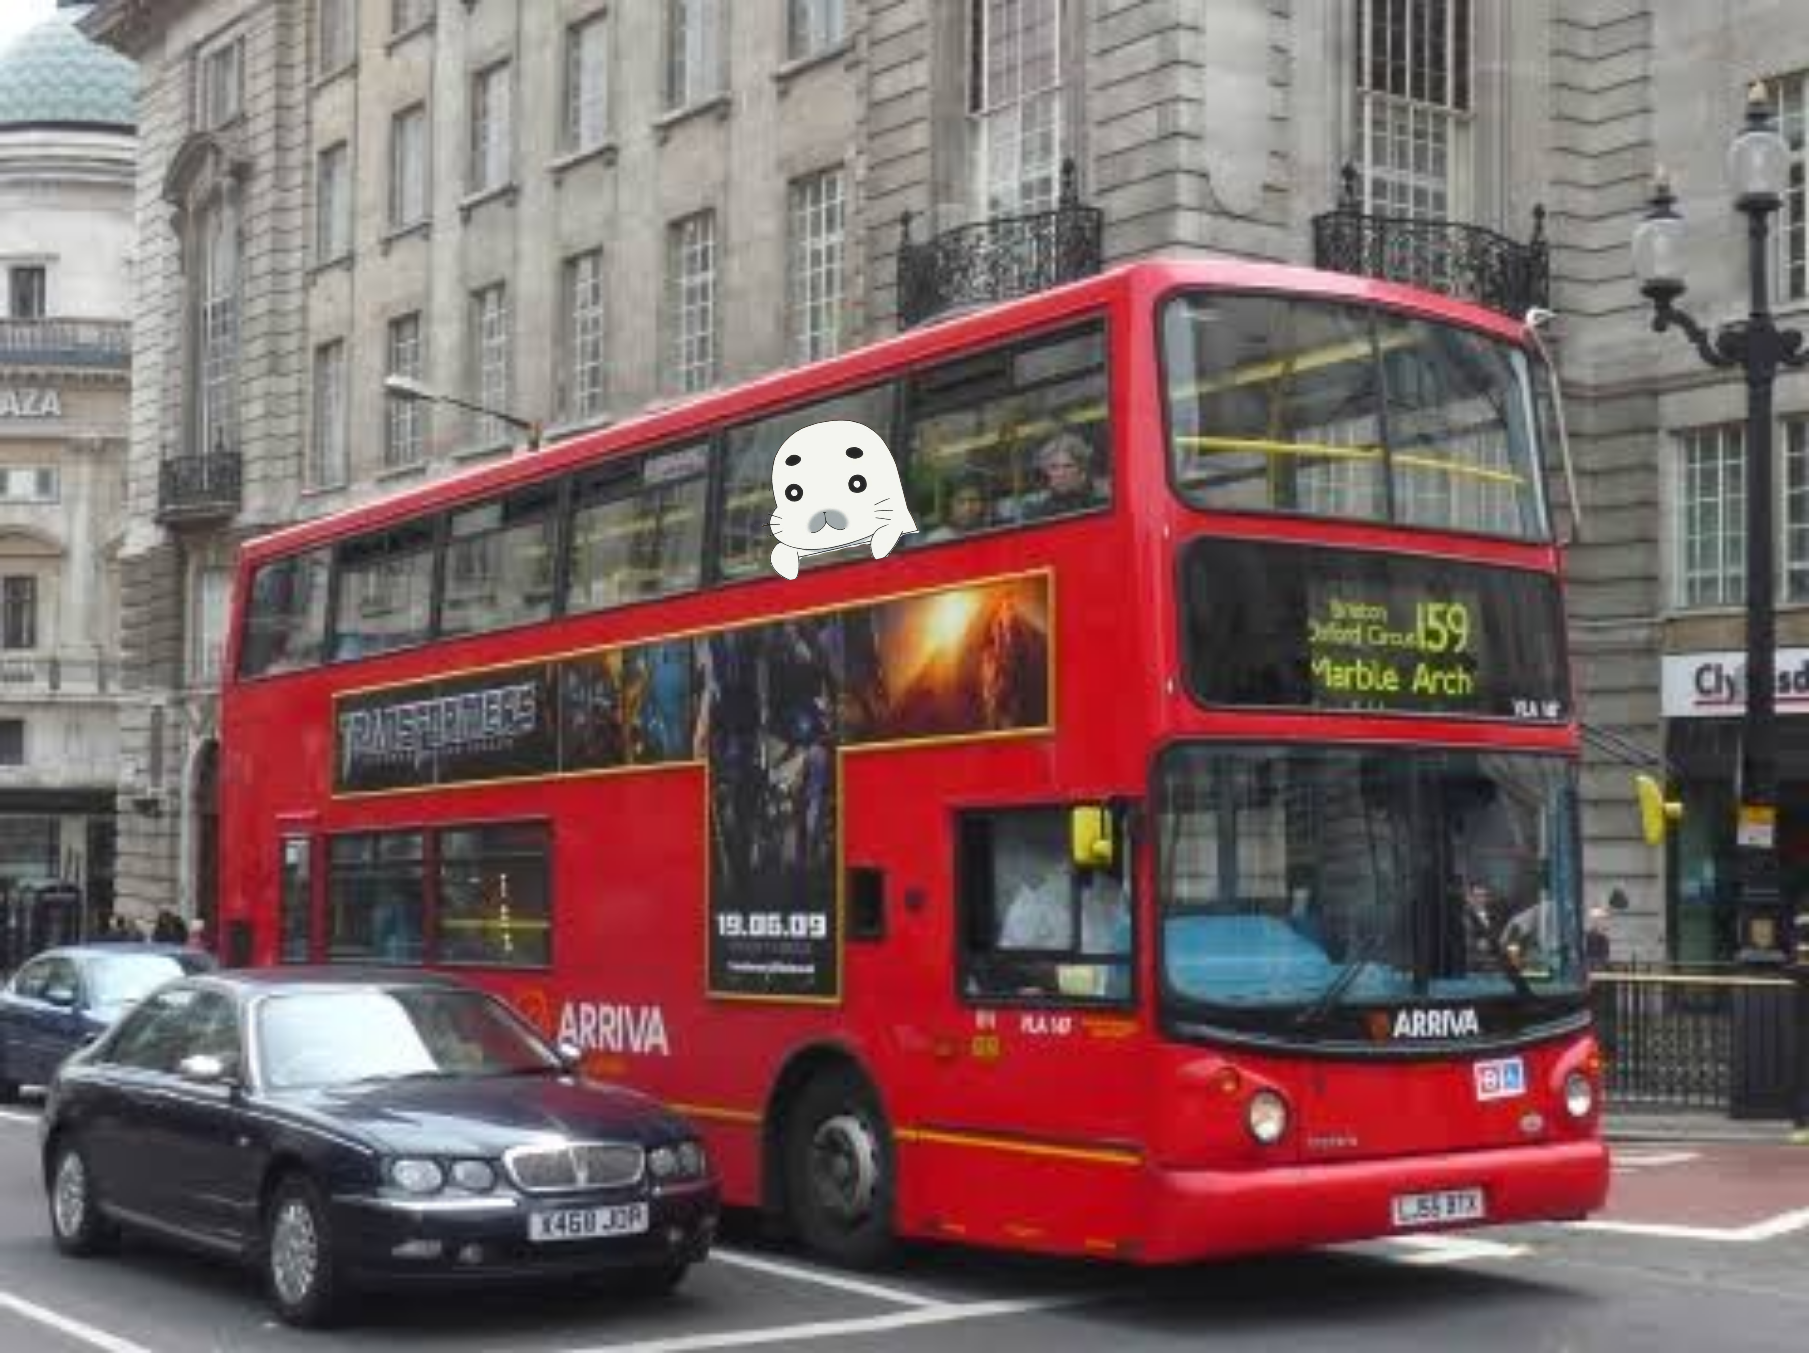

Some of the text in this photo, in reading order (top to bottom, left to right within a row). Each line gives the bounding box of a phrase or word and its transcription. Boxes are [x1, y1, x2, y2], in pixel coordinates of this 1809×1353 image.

[1416, 602, 1469, 653] 159
[1311, 656, 1473, 695] Marble Arch
[717, 912, 827, 938] 19.06.09
[557, 1000, 671, 1056] ARRIVA
[1392, 1004, 1479, 1038] ARRIVA
